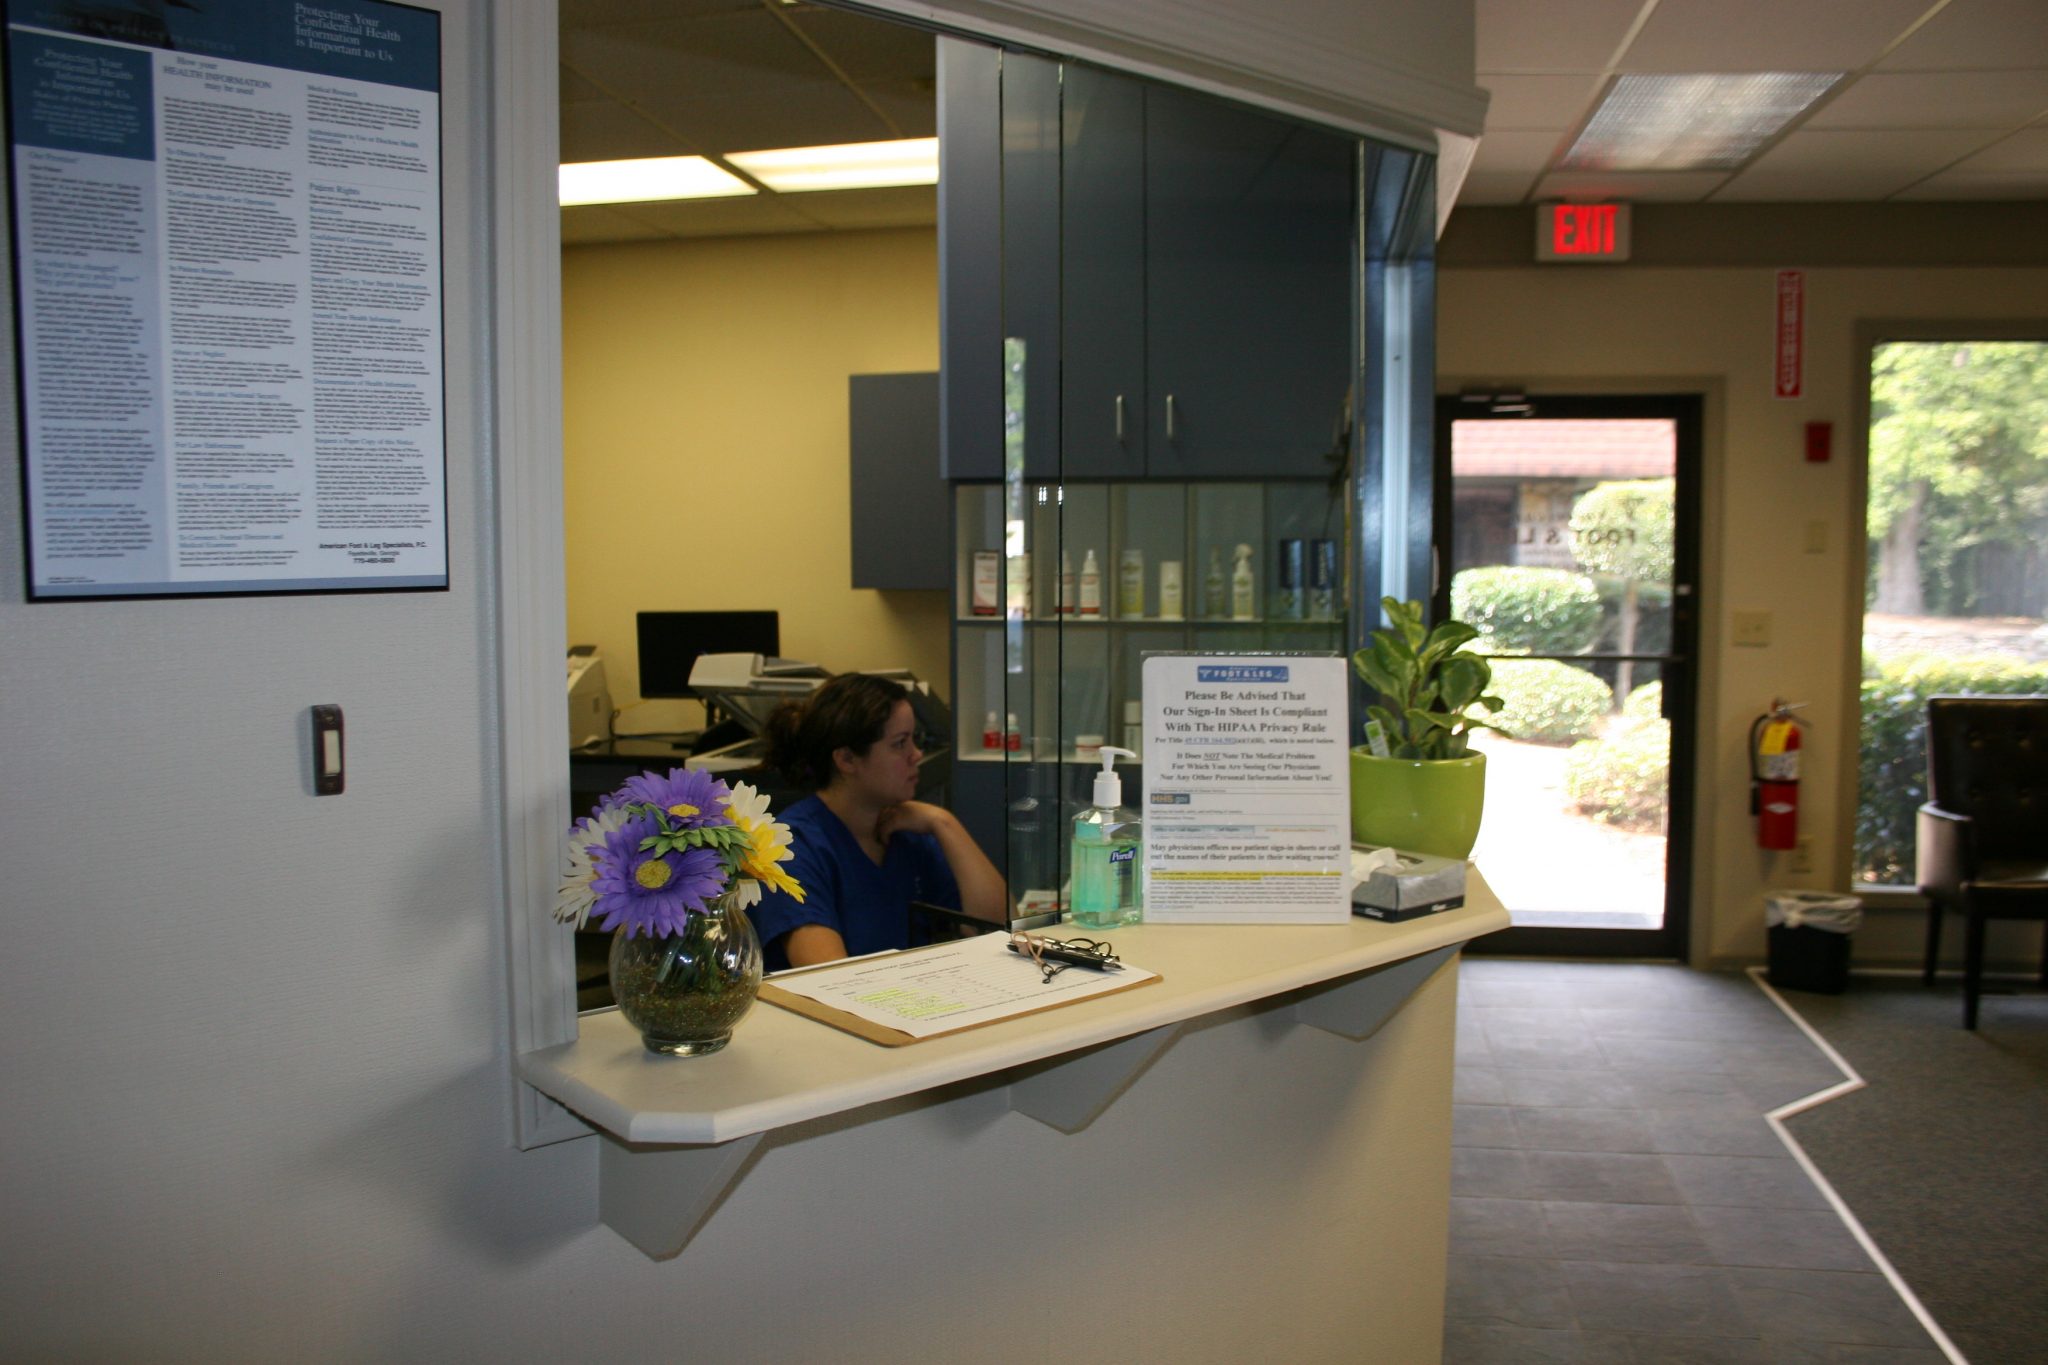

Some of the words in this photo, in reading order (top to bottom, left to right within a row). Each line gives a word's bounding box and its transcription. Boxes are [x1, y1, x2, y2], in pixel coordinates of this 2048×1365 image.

[295, 2, 350, 24] Protecting
[354, 13, 380, 27] Your
[295, 14, 362, 35] Confidential
[366, 25, 401, 42] Health
[296, 25, 360, 45] Information
[296, 38, 305, 47] is
[309, 38, 361, 57] Important
[365, 50, 375, 59] to
[379, 50, 393, 62] Us
[163, 65, 202, 80] HEALTH
[205, 72, 272, 89] INFORMATION
[1553, 204, 1618, 255] EXIT
[370, 541, 381, 550] Leg
[382, 541, 415, 549] Specialists,
[1213, 669, 1241, 678] FOOT
[1243, 669, 1250, 678] &
[1252, 669, 1273, 678] LEG
[1185, 690, 1217, 701] Please
[1220, 690, 1233, 701] Be
[1237, 690, 1278, 701] Advised
[1281, 690, 1306, 701] That
[1163, 706, 1184, 717] Our
[1187, 706, 1226, 719] Sign-In
[1229, 706, 1257, 717] Sheet
[1260, 706, 1270, 717] Is
[1272, 706, 1328, 720] Compliant
[1165, 722, 1191, 733] With
[1195, 722, 1214, 733] The
[1218, 722, 1257, 733] HIPAA
[1260, 722, 1299, 735] Privacy
[1302, 722, 1327, 733] Rule
[1243, 763, 1266, 772] Seeing
[1176, 774, 1190, 782] Any
[1151, 794, 1189, 805] HHS.gov
[1151, 844, 1166, 852] May
[1168, 844, 1205, 852] physicians
[1206, 843, 1229, 851] offices
[1244, 844, 1268, 852] patient
[1270, 844, 1294, 852] sign-in
[1112, 850, 1135, 861] Purell
[1228, 853, 1257, 861] patients
[1285, 853, 1312, 862] waiting
